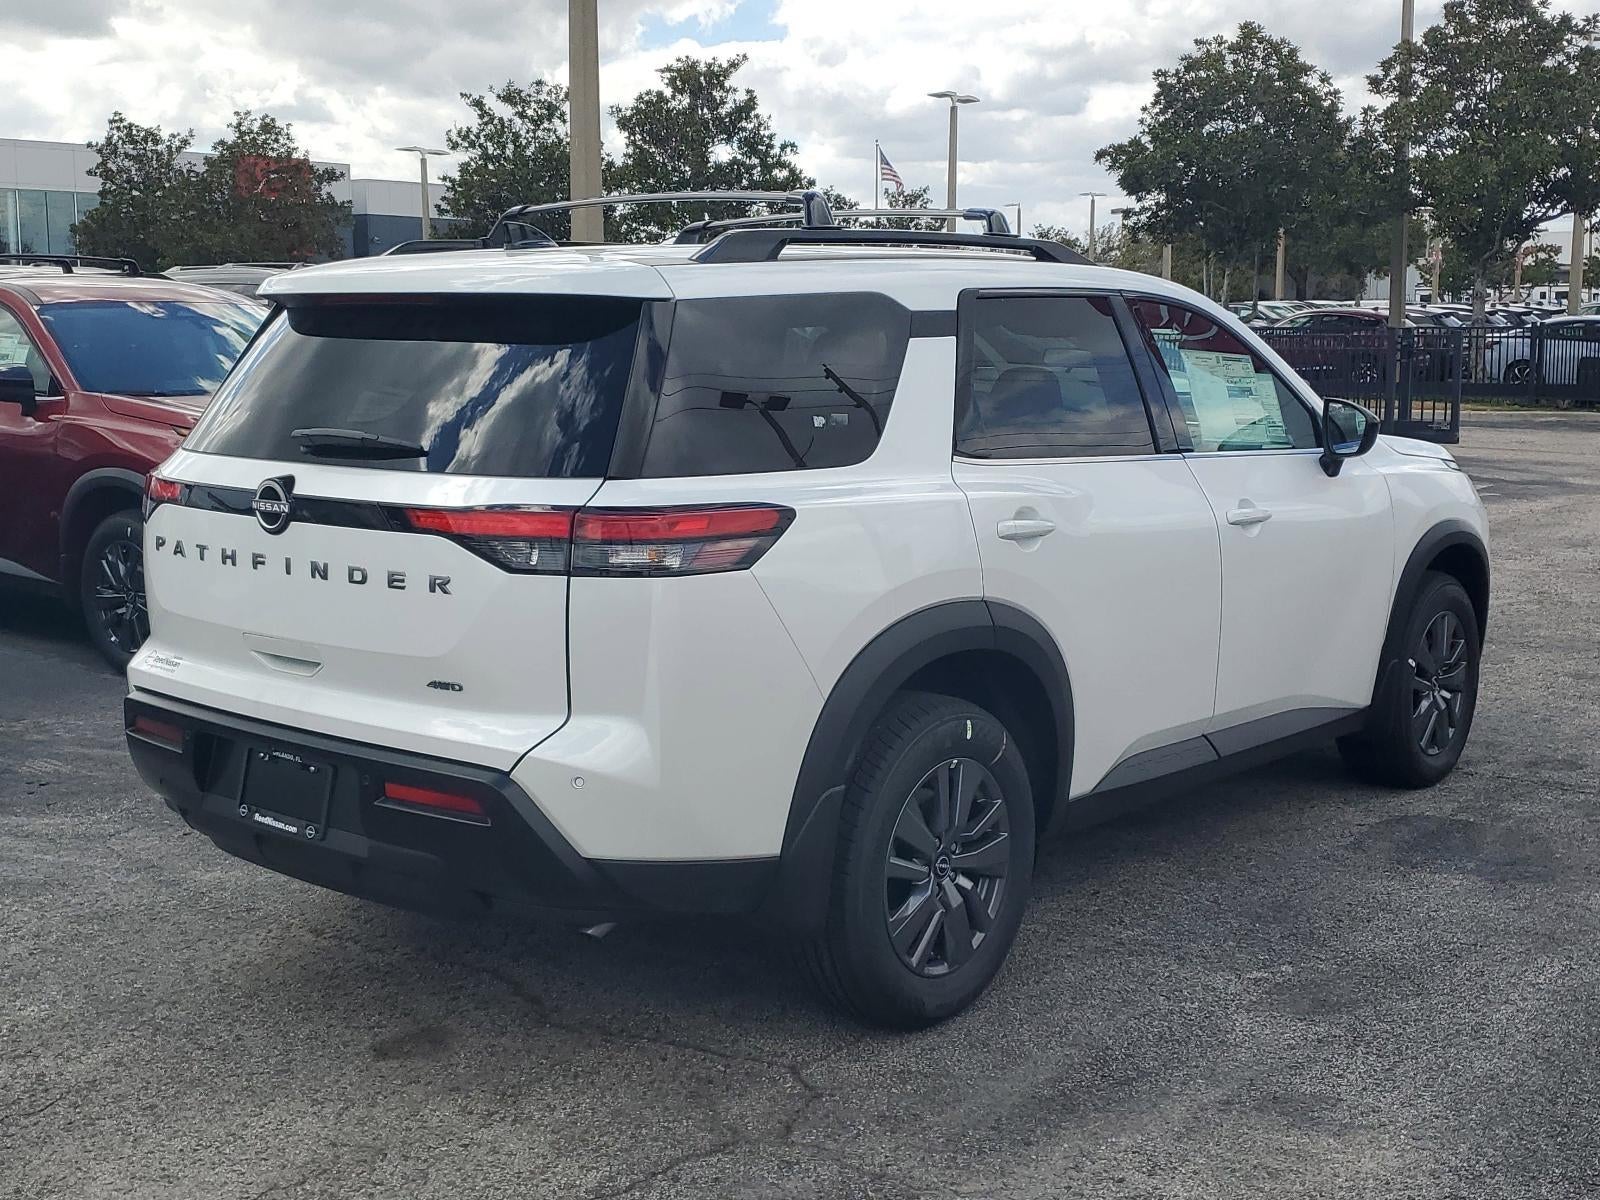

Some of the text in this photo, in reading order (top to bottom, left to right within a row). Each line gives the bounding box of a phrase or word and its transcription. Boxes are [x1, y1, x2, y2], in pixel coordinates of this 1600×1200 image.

[252, 501, 289, 513] NISSAN
[155, 535, 452, 595] PATHFINDER
[426, 680, 464, 691] 4WD
